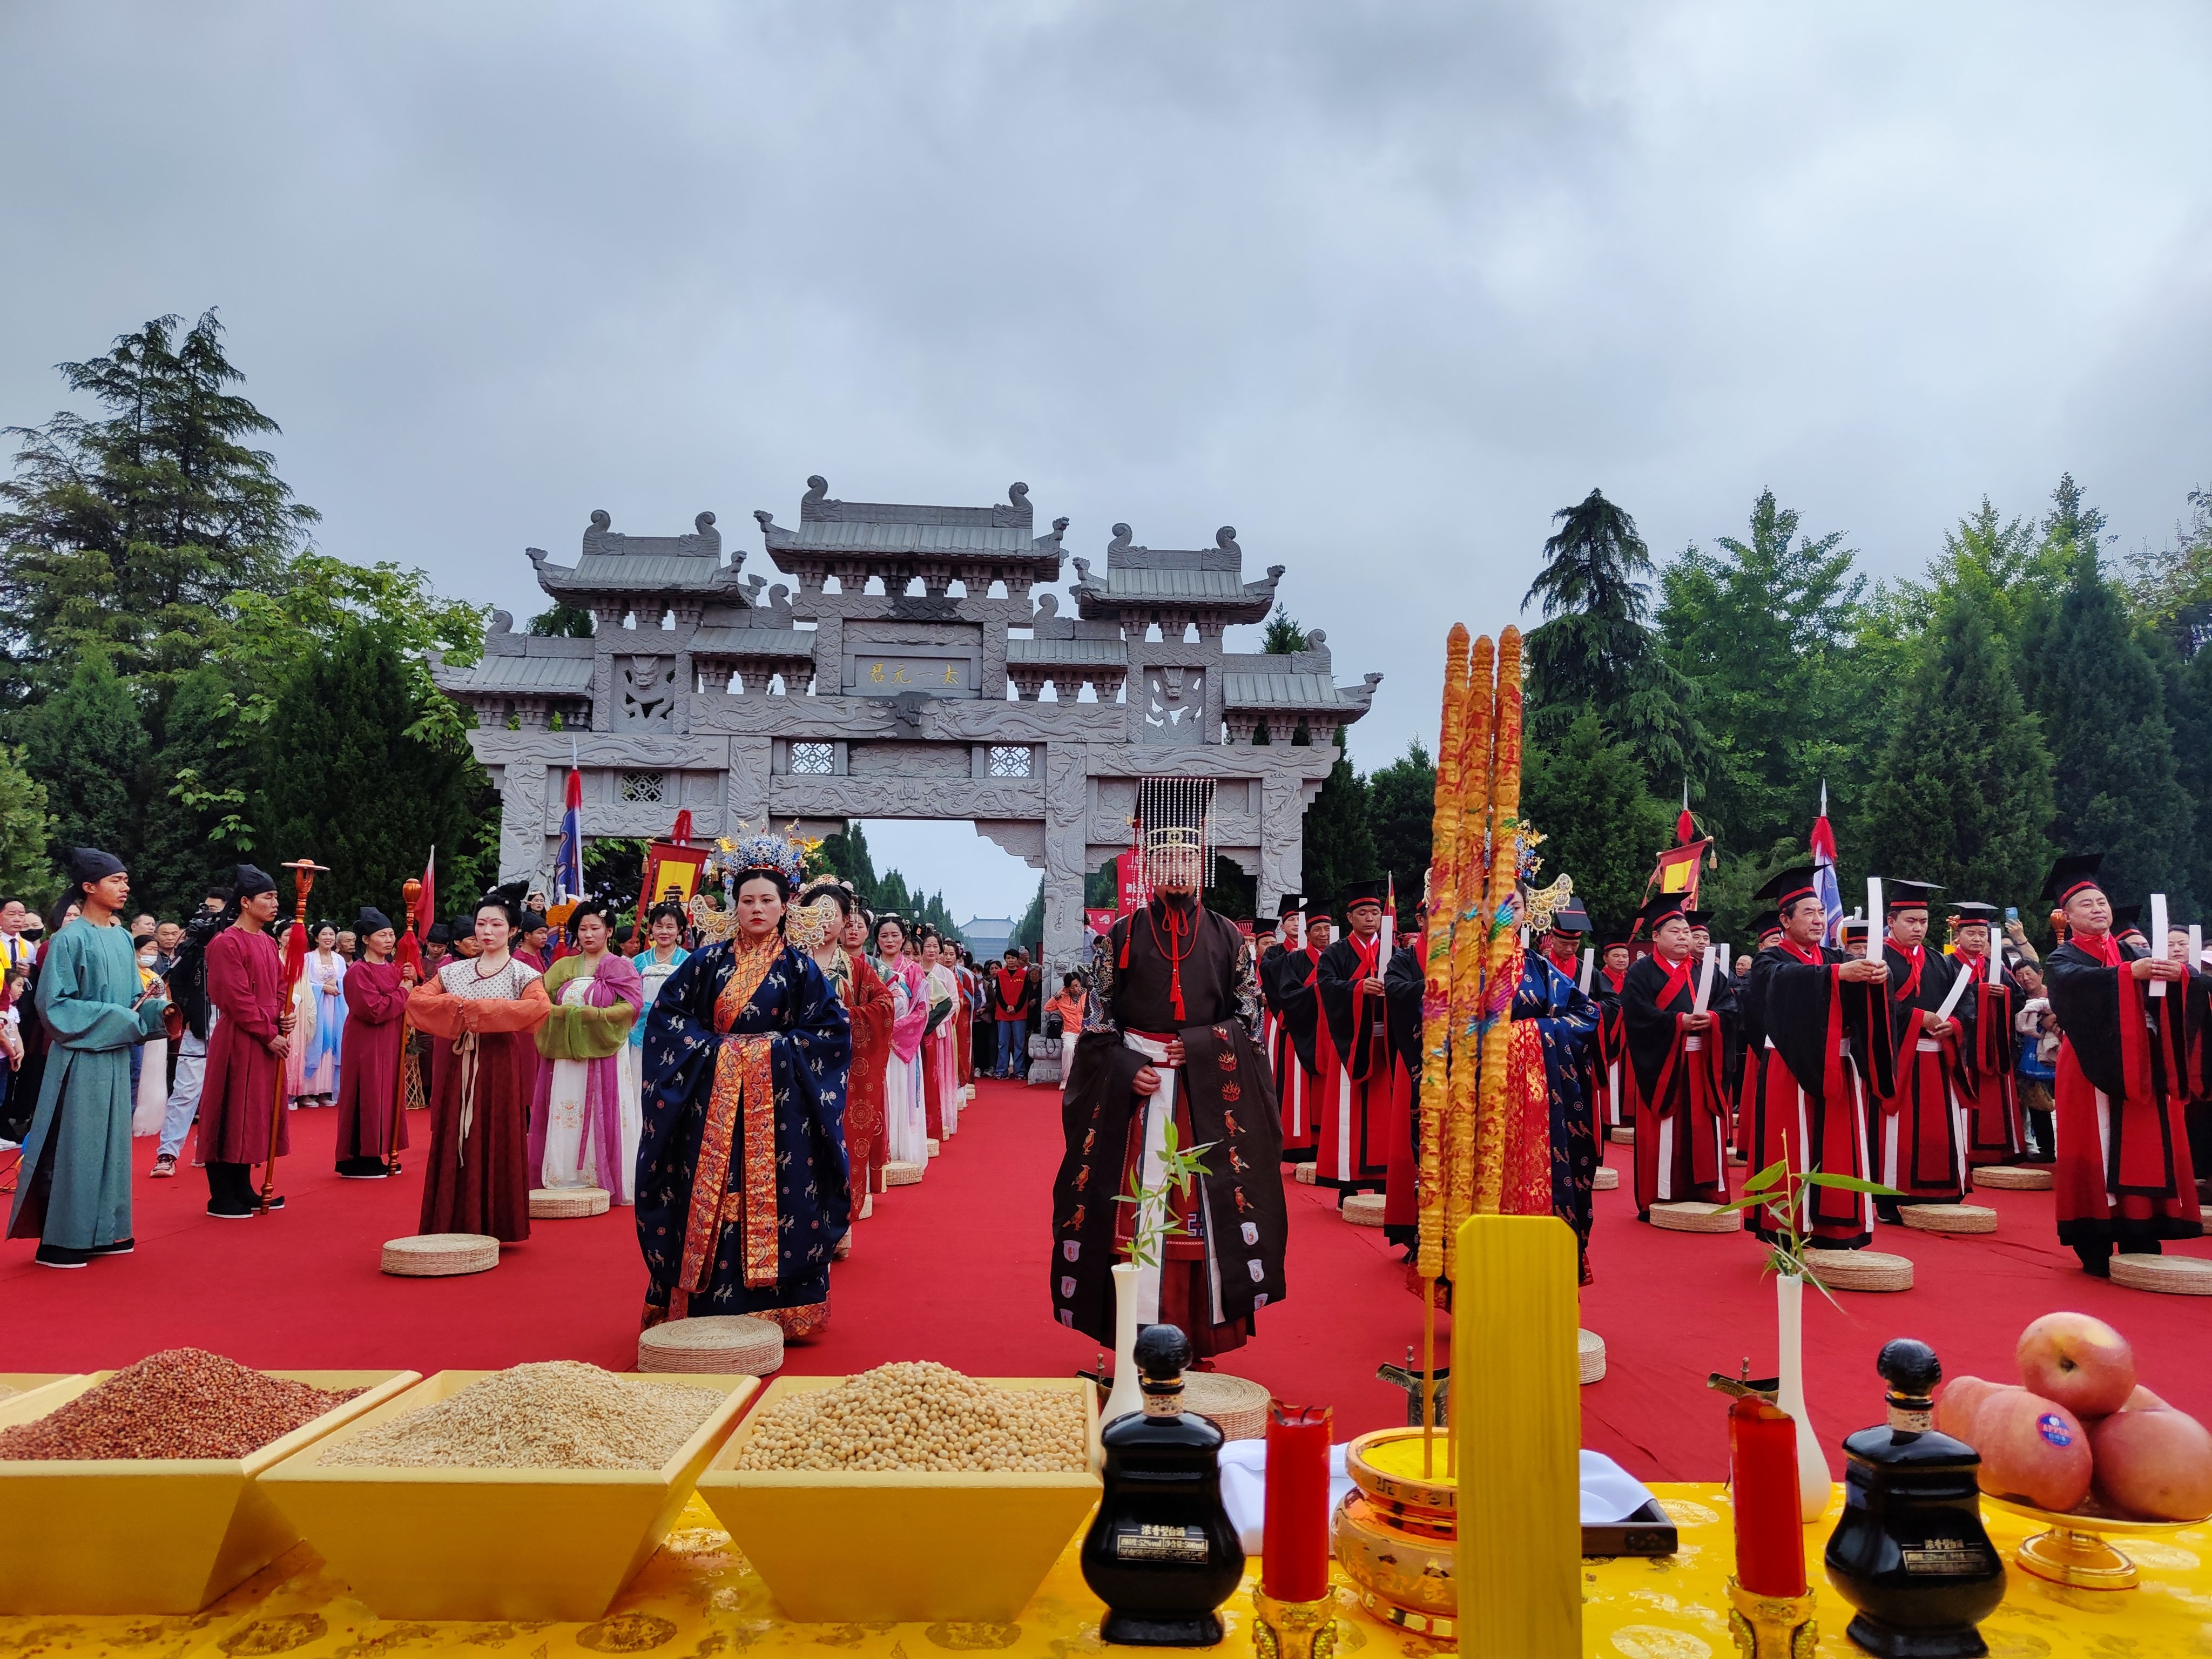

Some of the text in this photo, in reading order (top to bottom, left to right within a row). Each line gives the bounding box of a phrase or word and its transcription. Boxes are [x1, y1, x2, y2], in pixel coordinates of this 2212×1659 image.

[1141, 1524, 1186, 1537] 浓香型白酒
